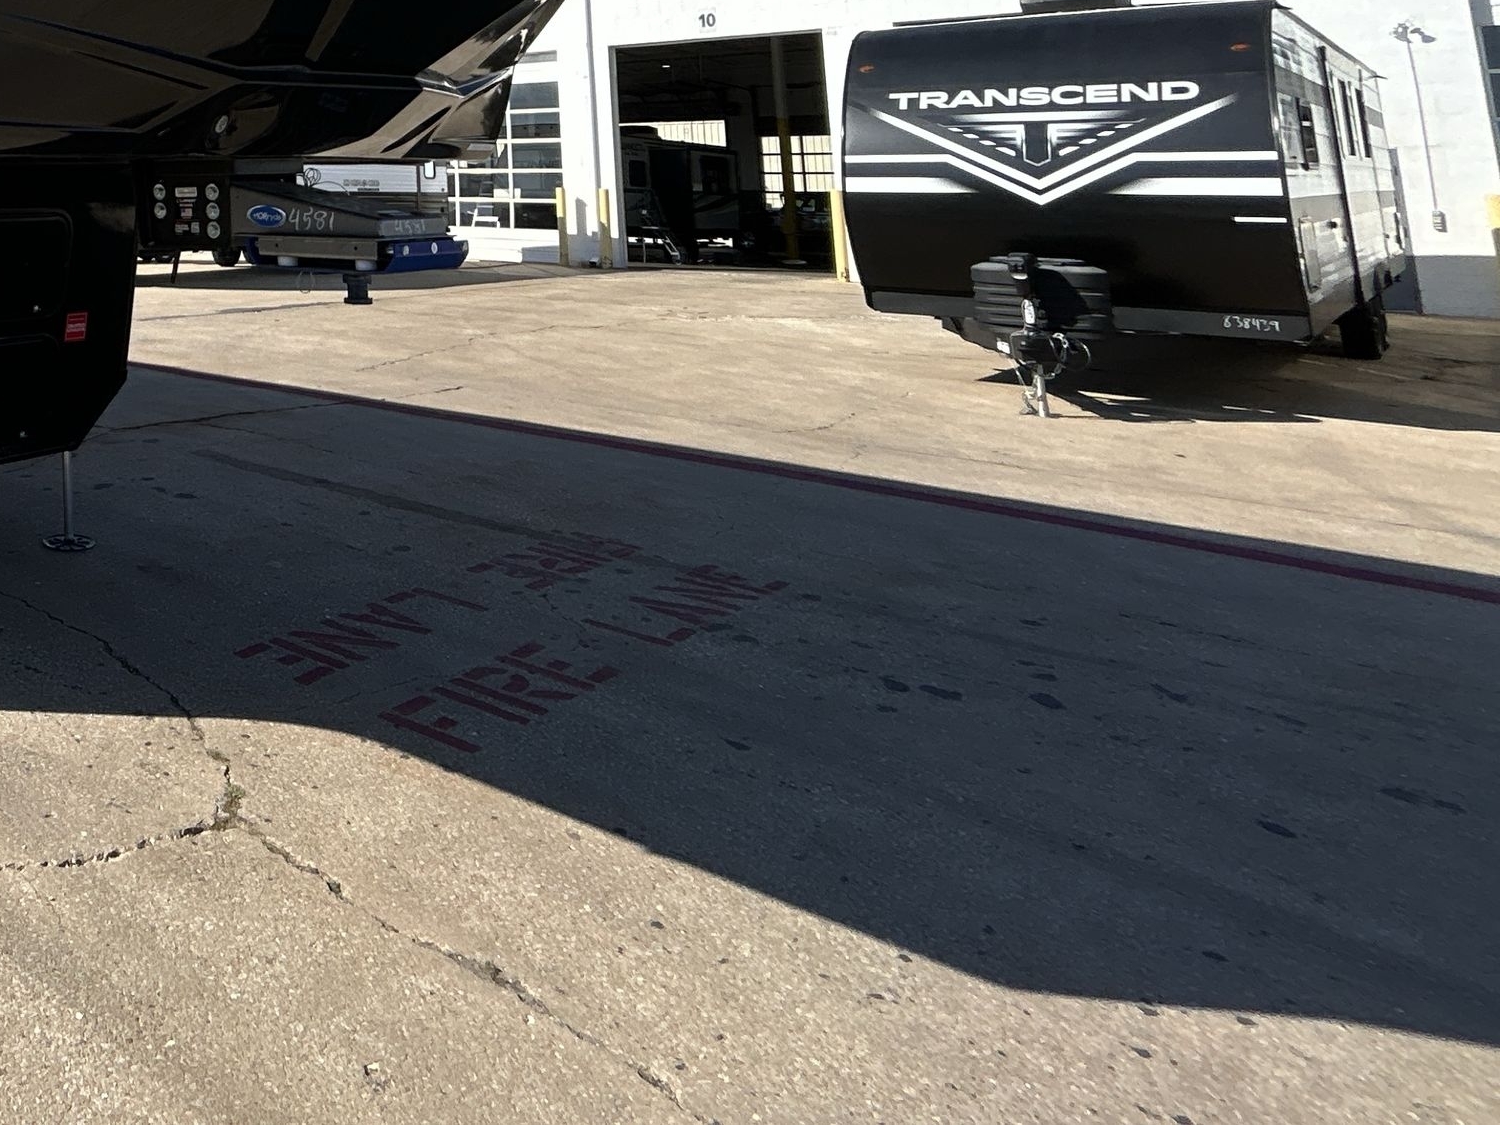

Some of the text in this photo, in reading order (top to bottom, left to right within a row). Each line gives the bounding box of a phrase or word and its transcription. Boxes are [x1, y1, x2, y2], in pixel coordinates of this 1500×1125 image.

[698, 12, 716, 28] 10
[888, 80, 1200, 110] TRANSCEND
[288, 207, 335, 231] 4581
[378, 564, 790, 753] FIRE LANE
